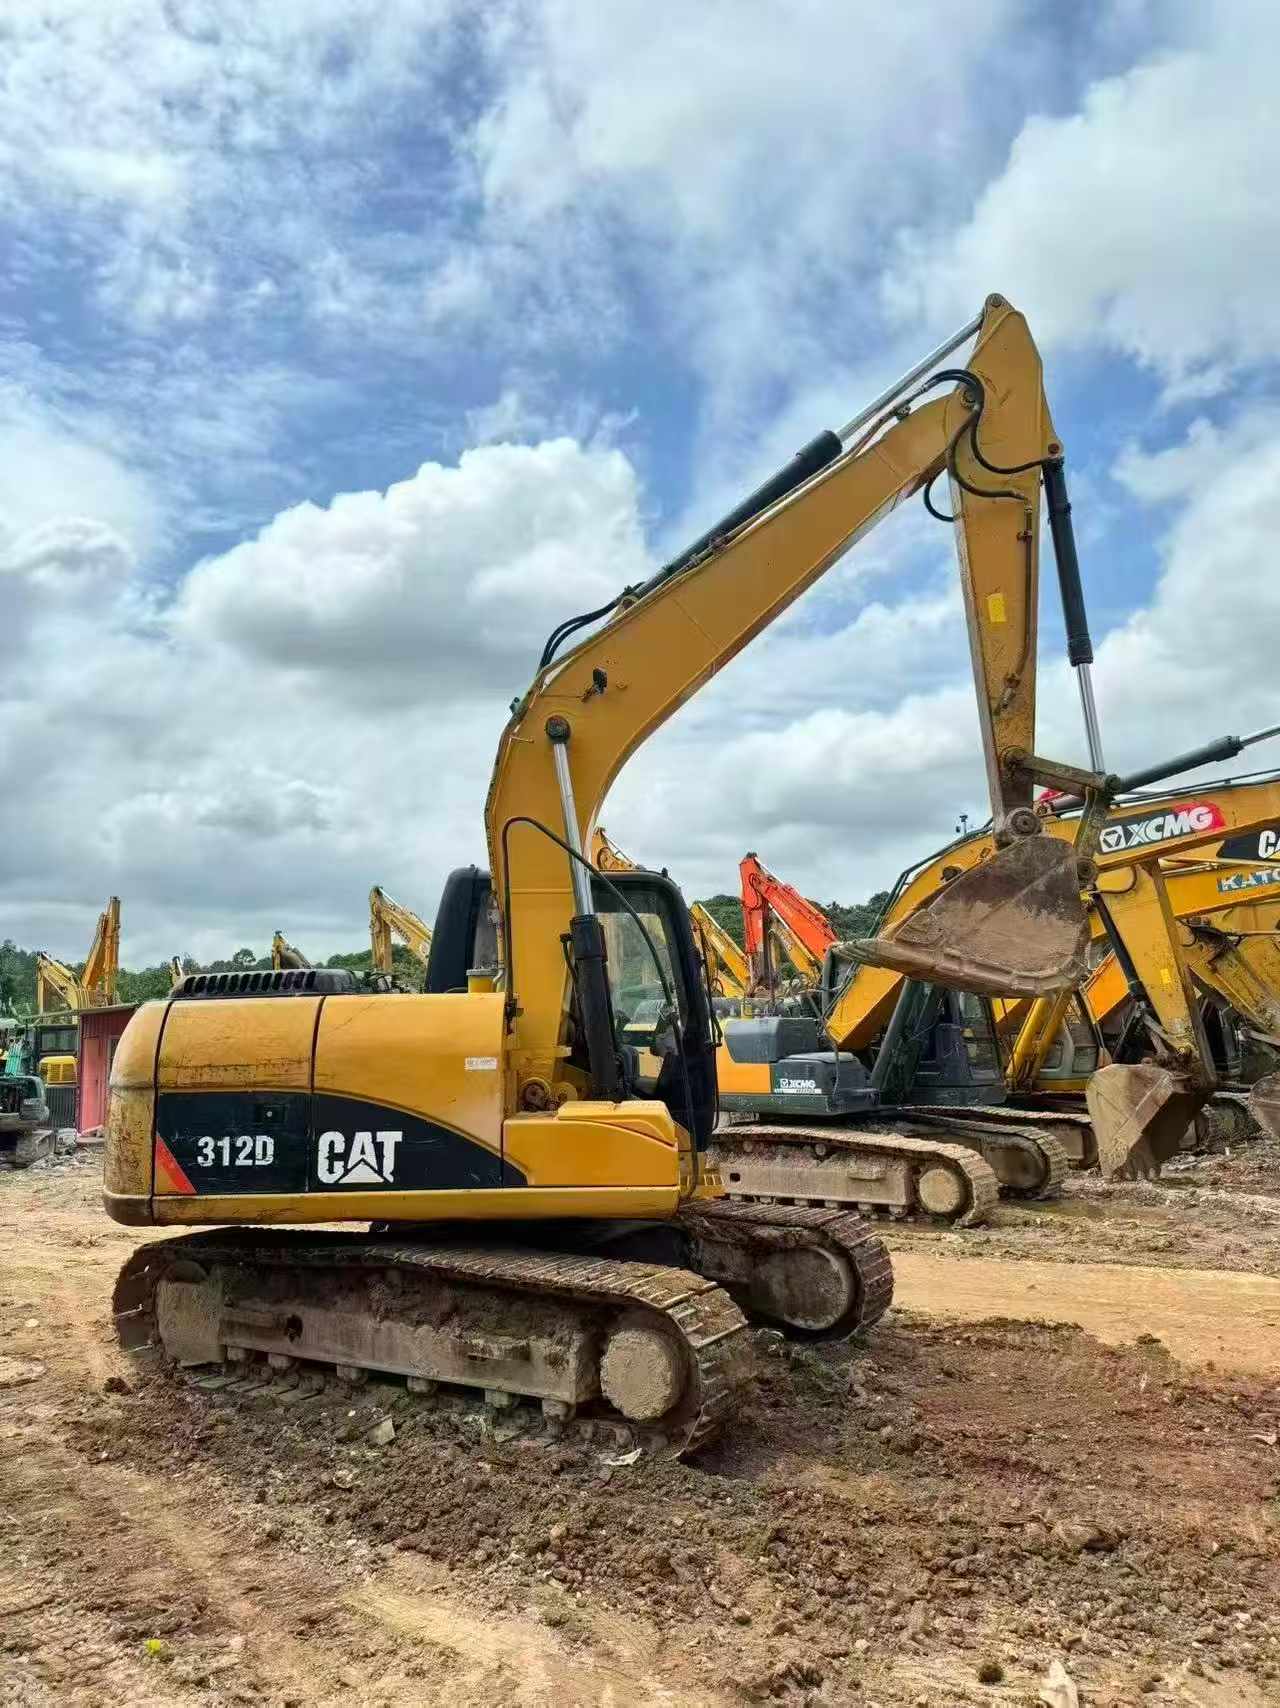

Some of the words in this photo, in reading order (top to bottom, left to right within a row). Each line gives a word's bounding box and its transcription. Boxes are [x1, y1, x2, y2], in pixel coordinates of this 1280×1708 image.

[1127, 806, 1213, 847] XCMG
[197, 1135, 275, 1167] 312D
[317, 1130, 402, 1184] CAT
